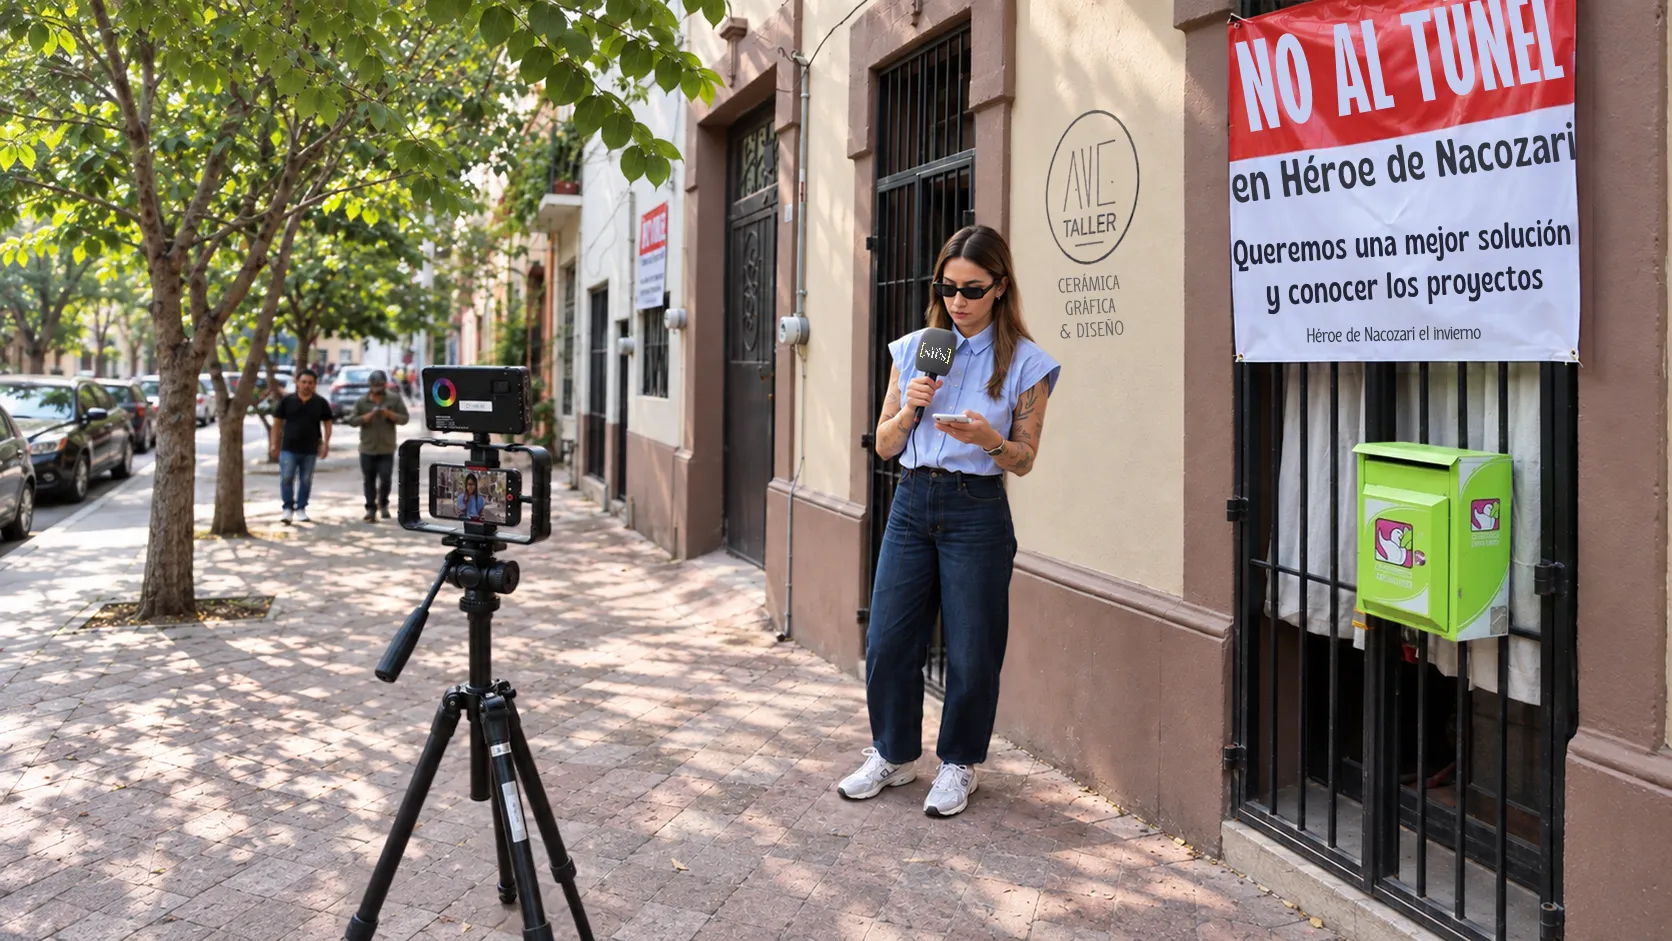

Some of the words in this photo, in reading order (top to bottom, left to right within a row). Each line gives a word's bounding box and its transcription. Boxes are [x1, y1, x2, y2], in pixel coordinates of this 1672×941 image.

[1235, 33, 1312, 132] NO
[1333, 19, 1395, 116] AL
[1232, 170, 1270, 203] en
[1281, 155, 1376, 197] Héroe
[1387, 145, 1425, 183] de
[1436, 122, 1576, 177] Nacozari
[1063, 212, 1116, 238] TALLER
[1233, 239, 1347, 272] Queremos
[1356, 236, 1397, 258] una
[1406, 226, 1469, 261] mejor
[1478, 219, 1571, 250] solución
[1058, 273, 1120, 293] CERÁMICA
[1266, 285, 1280, 314] y
[1289, 278, 1377, 305] conocer
[1387, 272, 1418, 299] los
[1428, 266, 1543, 304] proyectos
[1065, 296, 1116, 316] GRÁFICA
[1060, 323, 1071, 339] &
[1077, 319, 1124, 338] DISEÑO
[1306, 327, 1342, 343] Héroe
[1346, 327, 1360, 342] de
[1419, 325, 1429, 340] el
[1433, 326, 1481, 340] invierno
